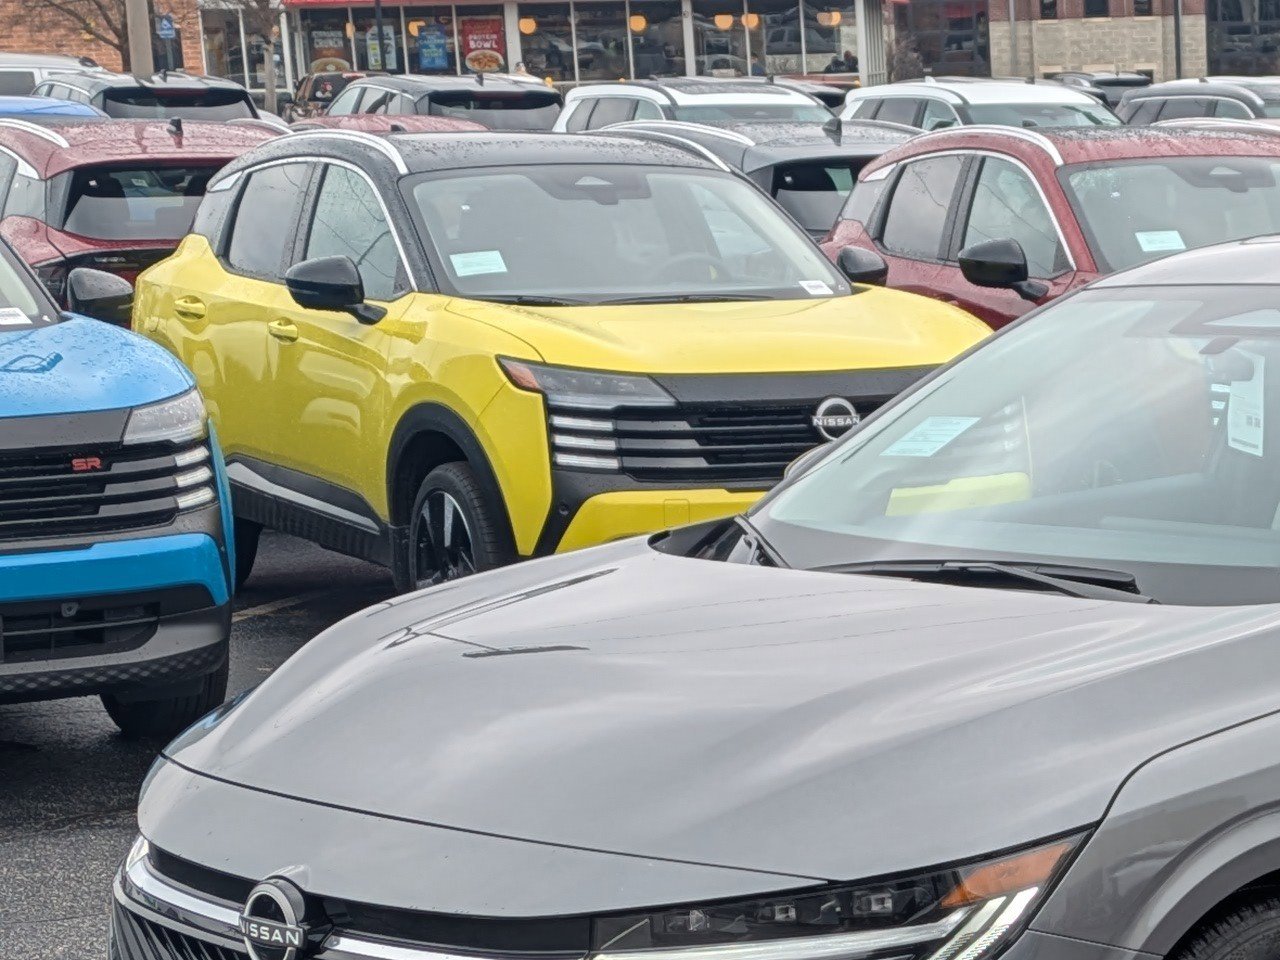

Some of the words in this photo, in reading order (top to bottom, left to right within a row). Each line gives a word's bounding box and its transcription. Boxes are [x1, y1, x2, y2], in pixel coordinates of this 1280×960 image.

[468, 40, 498, 49] BOWL
[813, 416, 860, 427] NISSAN
[72, 457, 101, 471] SR
[240, 919, 299, 945] NISSAN
